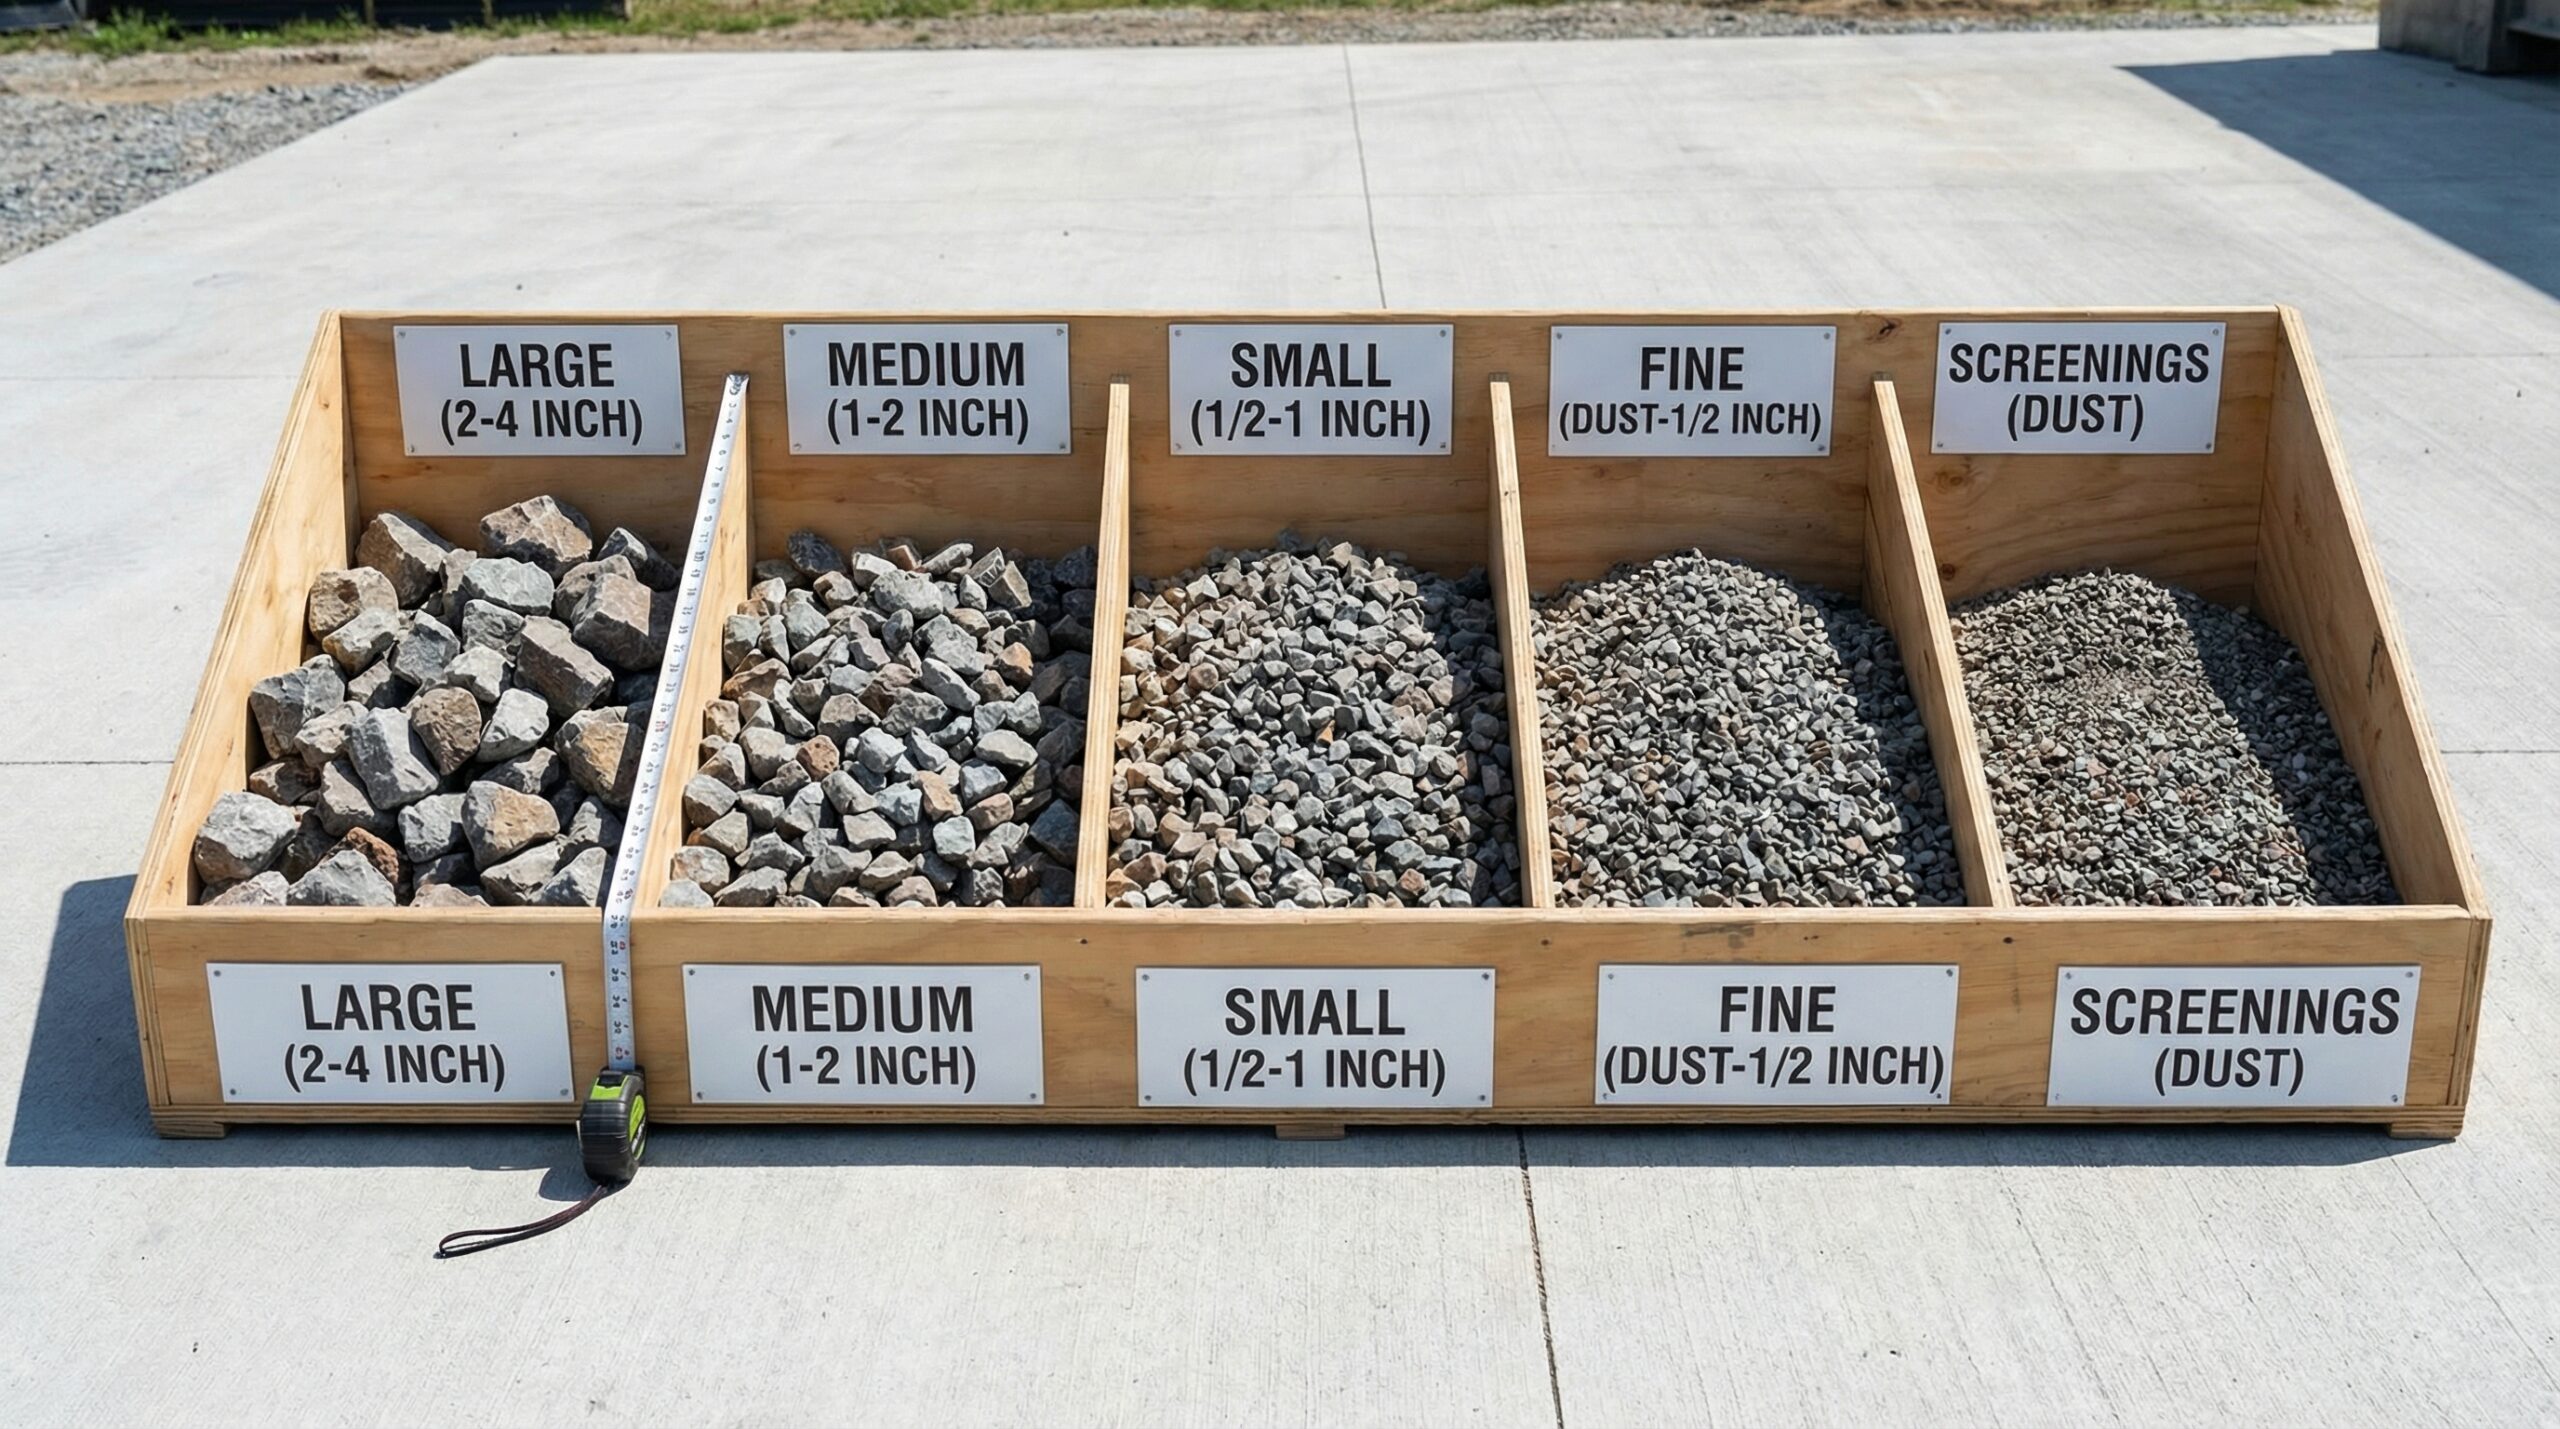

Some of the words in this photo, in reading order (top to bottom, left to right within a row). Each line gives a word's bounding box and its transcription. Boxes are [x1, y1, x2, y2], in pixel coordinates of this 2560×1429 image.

[459, 342, 615, 389] LARGE
[828, 341, 1025, 387] MEDIUM
[1231, 342, 1392, 389] SMALL
[1640, 346, 1745, 391] FINE
[1948, 342, 2210, 384] SCREENINGS
[441, 398, 519, 447] (2-4
[532, 398, 643, 447] INCH)
[827, 398, 905, 446] (1-2
[919, 397, 1029, 446] INCH)
[1191, 399, 1301, 447] (1/2-1
[1321, 399, 1431, 447] INCH)
[1559, 402, 1720, 442] (DUST-1/2
[1731, 402, 1821, 442] INCH)
[2007, 393, 2144, 443] (DUST)
[301, 983, 476, 1032] LARGE
[752, 985, 973, 1034] MEDIUM
[1225, 987, 1406, 1036] SMALL
[1720, 985, 1836, 1033] FINE
[2070, 987, 2400, 1036] SCREENINGS
[284, 1043, 370, 1093] (2-4
[384, 1043, 505, 1093] INCH)
[756, 1044, 840, 1093] (1-2
[855, 1045, 976, 1094] INCH)
[1184, 1047, 1304, 1097] (1/2-1
[1325, 1048, 1446, 1098] INCH)
[1604, 1045, 1813, 1096] (DUST-1/2
[1827, 1045, 1944, 1098] INCH)
[2154, 1047, 2304, 1097] (DUST)
